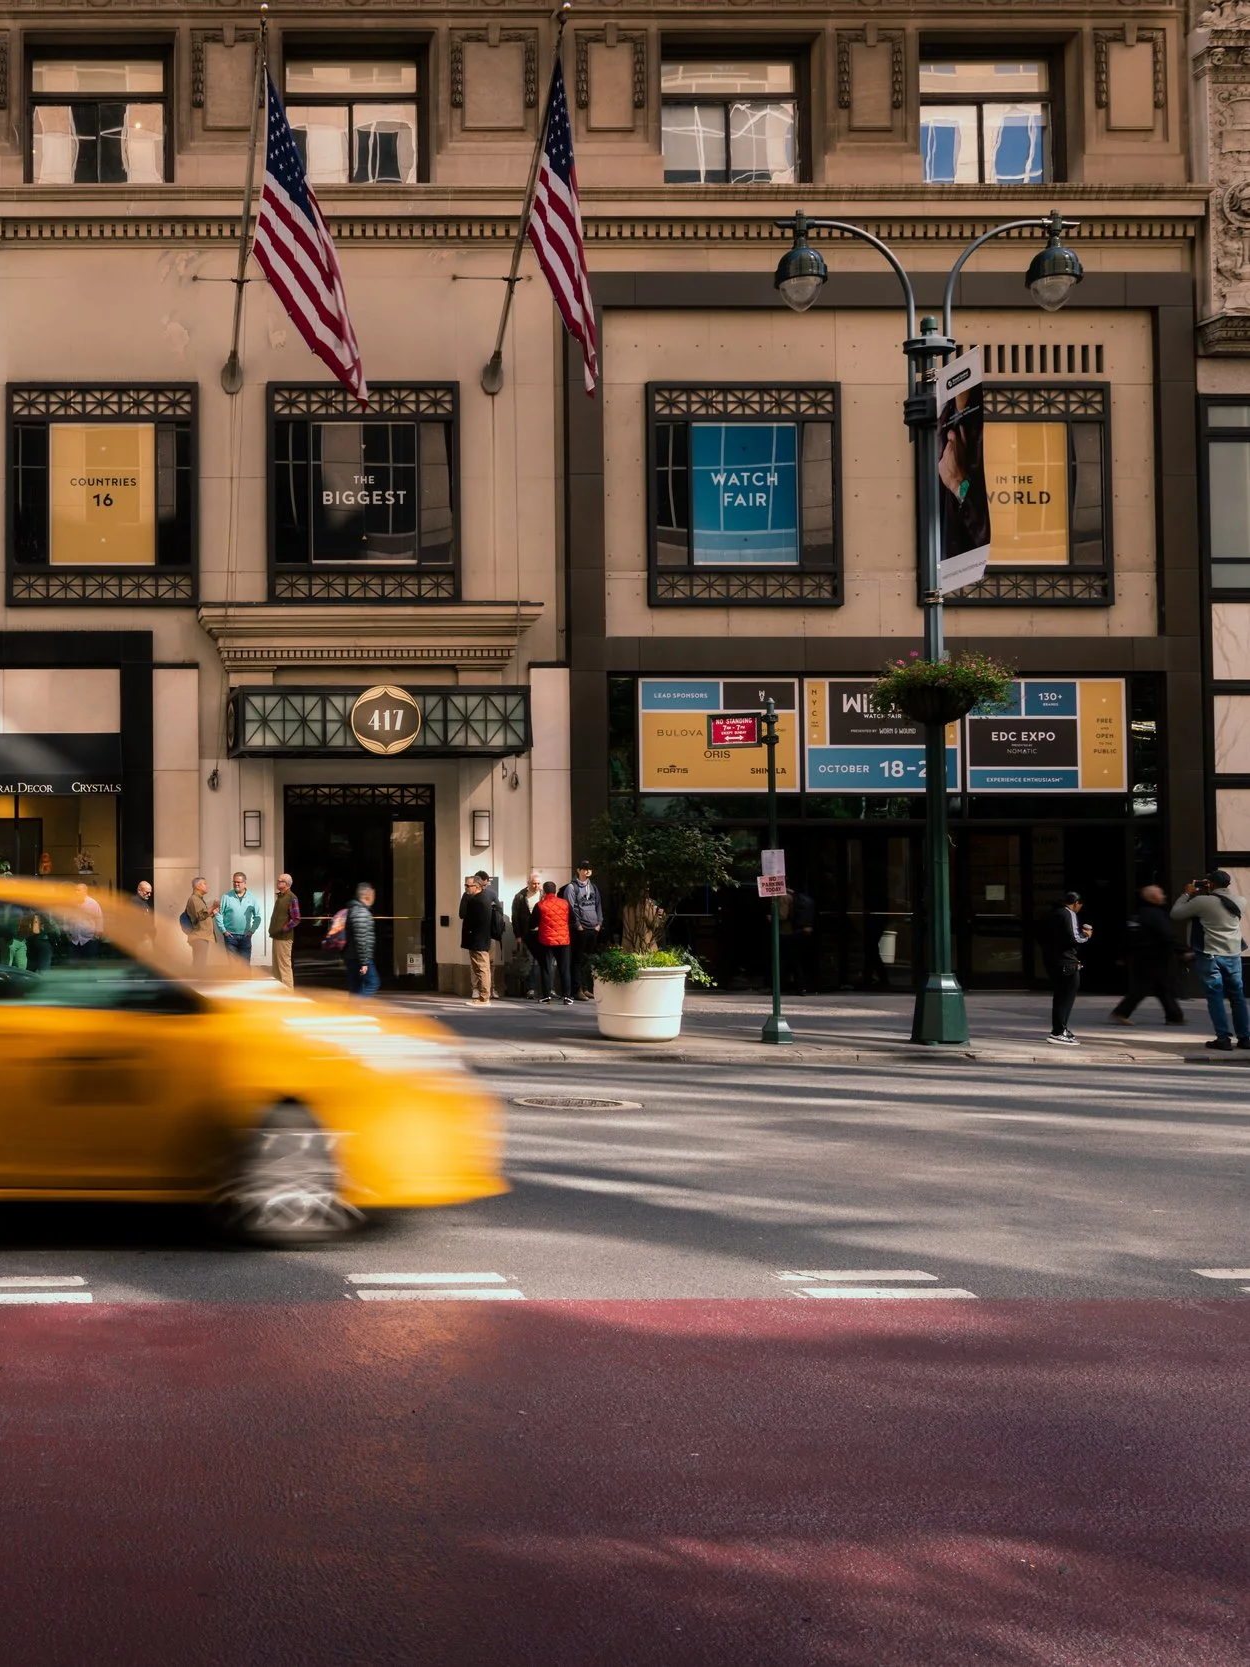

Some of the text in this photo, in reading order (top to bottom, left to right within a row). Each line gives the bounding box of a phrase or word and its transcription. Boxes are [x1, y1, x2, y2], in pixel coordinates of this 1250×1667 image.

[70, 477, 137, 487] COUNTRIES
[353, 475, 375, 484] THE
[710, 472, 778, 486] WATCH
[996, 475, 1033, 484] IN THE
[92, 493, 114, 507] 16
[322, 490, 407, 505] BIGGEST
[724, 493, 767, 506] FAIR
[1038, 692, 1063, 701] 130+
[367, 709, 404, 731] 417
[726, 717, 753, 725] STANDING
[656, 728, 703, 737] BULOVA
[991, 731, 1056, 742] EDC EXPO
[703, 750, 731, 759] ORIS
[750, 767, 787, 775] SHINLA
[818, 764, 870, 773] OCTOBER
[17, 782, 54, 793] DECOR
[71, 781, 122, 793] CRYSTALS
